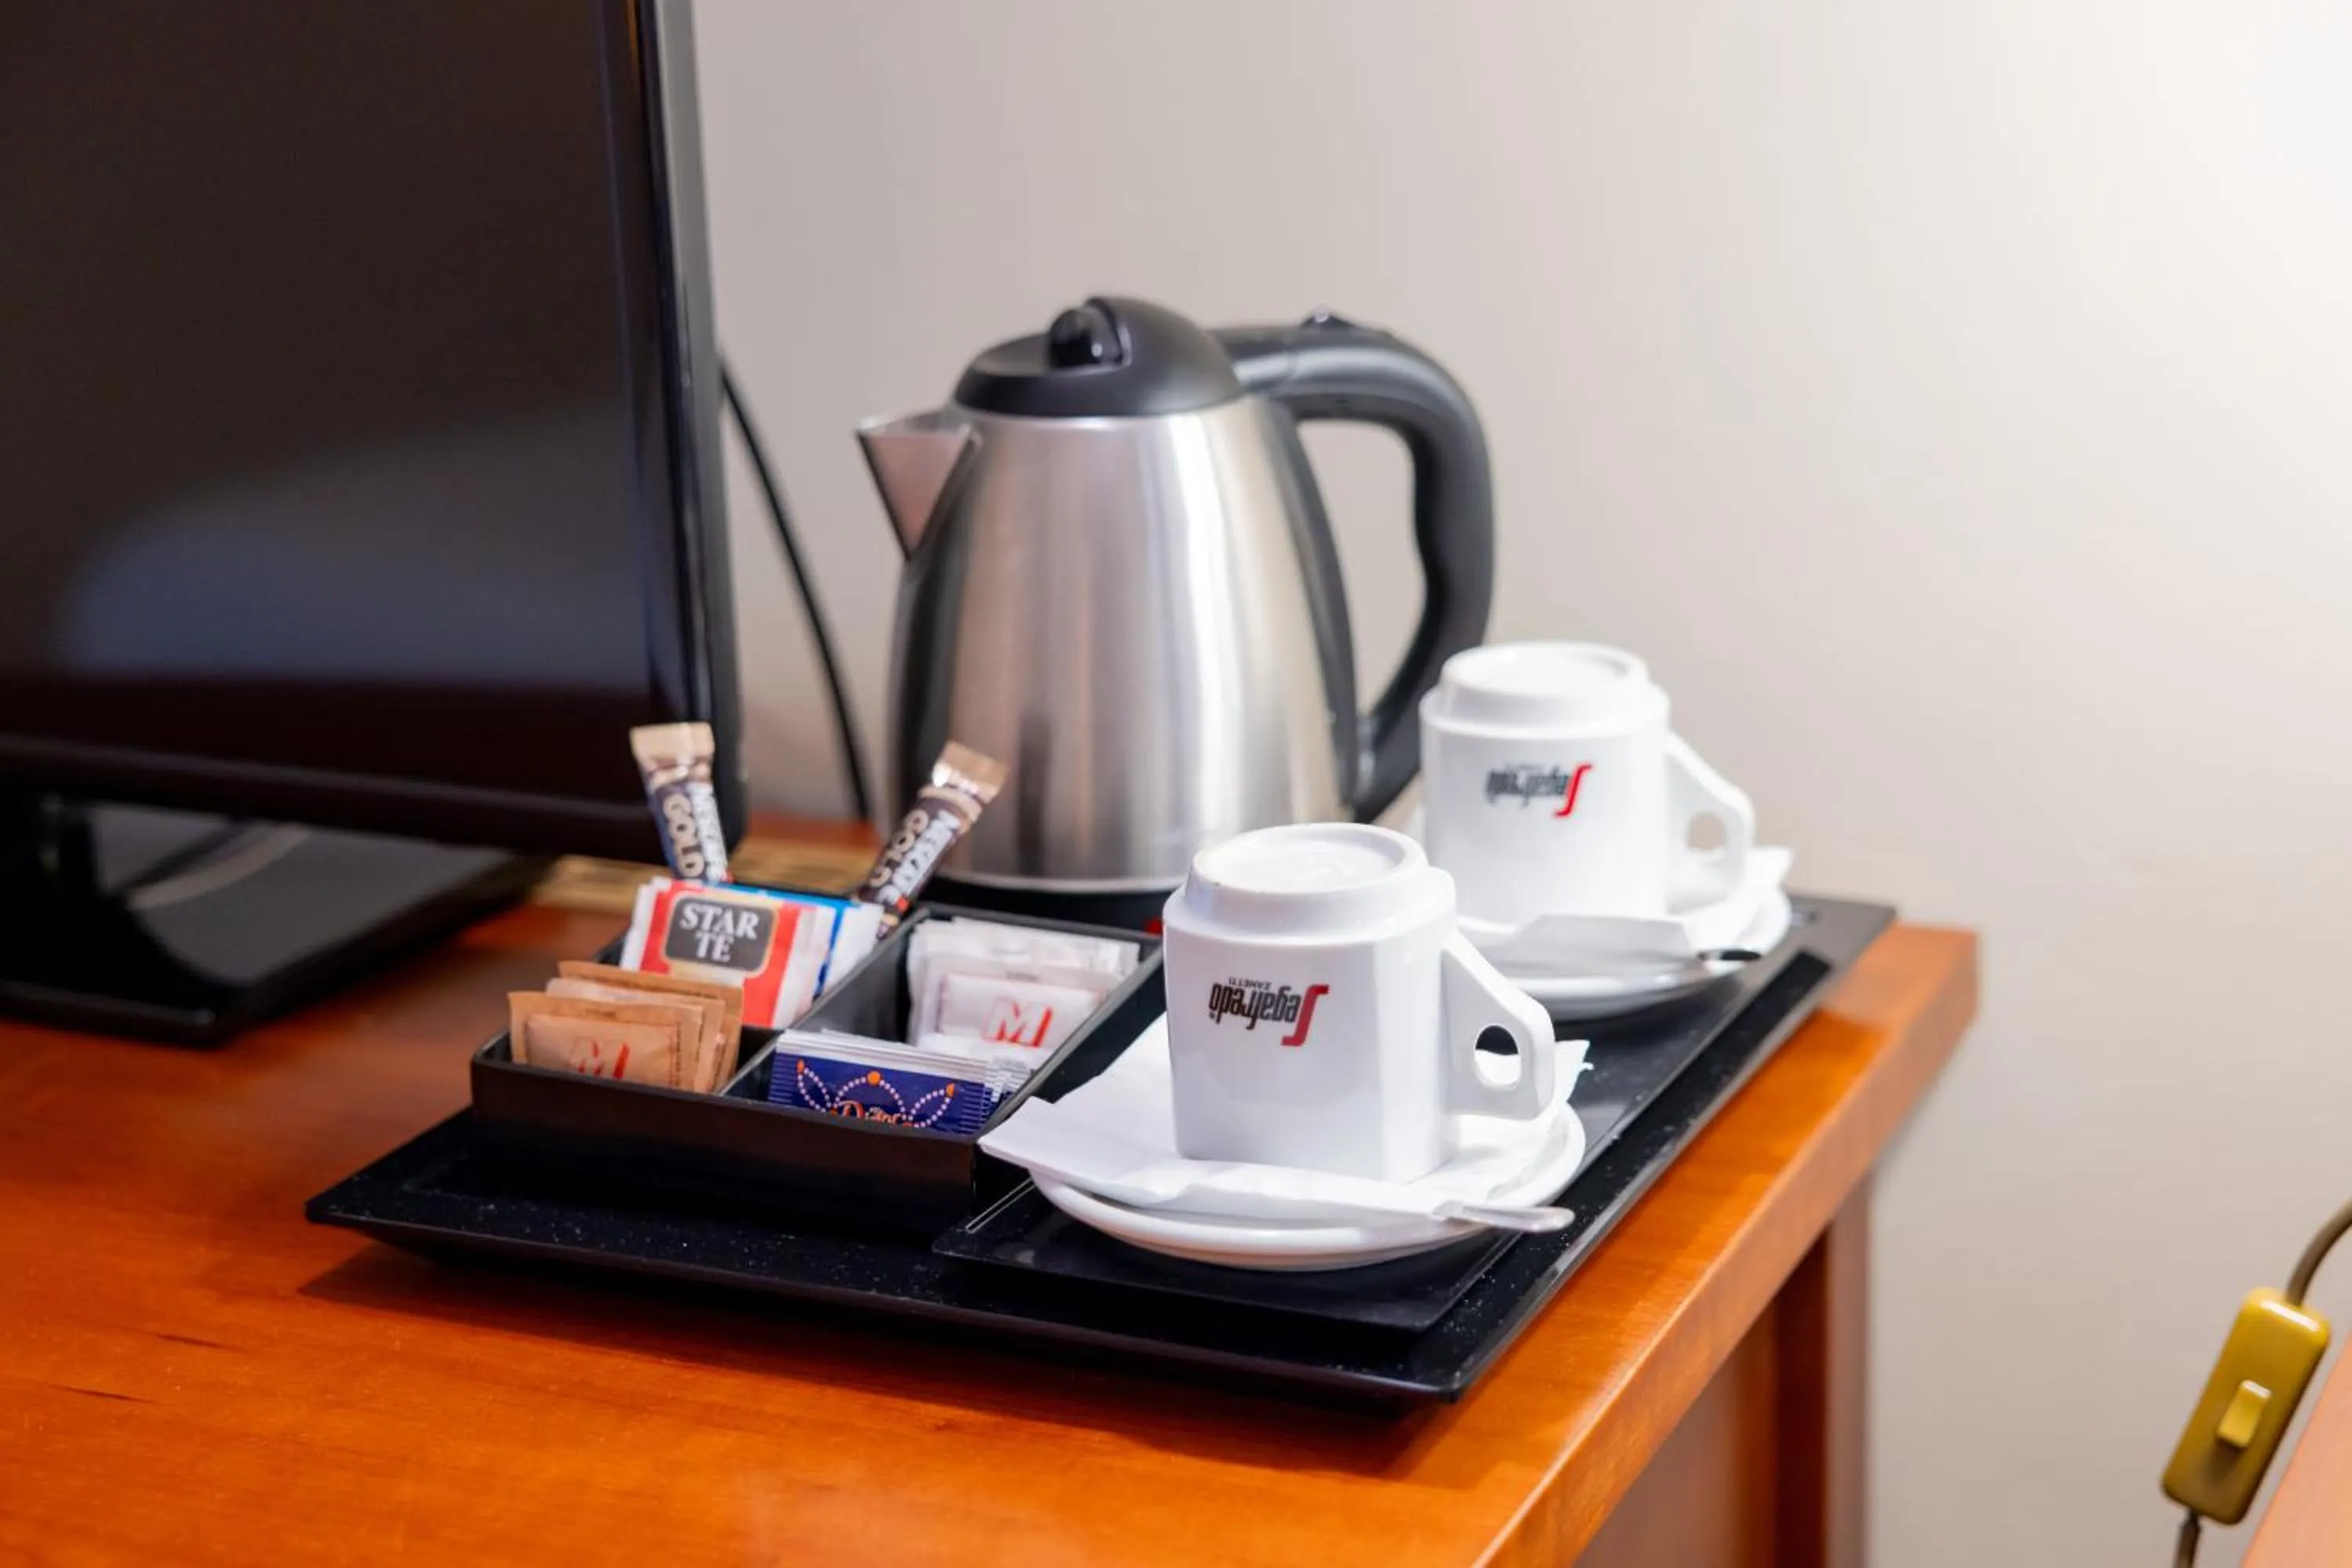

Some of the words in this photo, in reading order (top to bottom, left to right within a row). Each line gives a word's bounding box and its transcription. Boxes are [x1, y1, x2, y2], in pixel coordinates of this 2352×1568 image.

[662, 793, 705, 878] GOLD
[679, 902, 760, 940] STAR
[1208, 982, 1330, 1047] Segafredo
